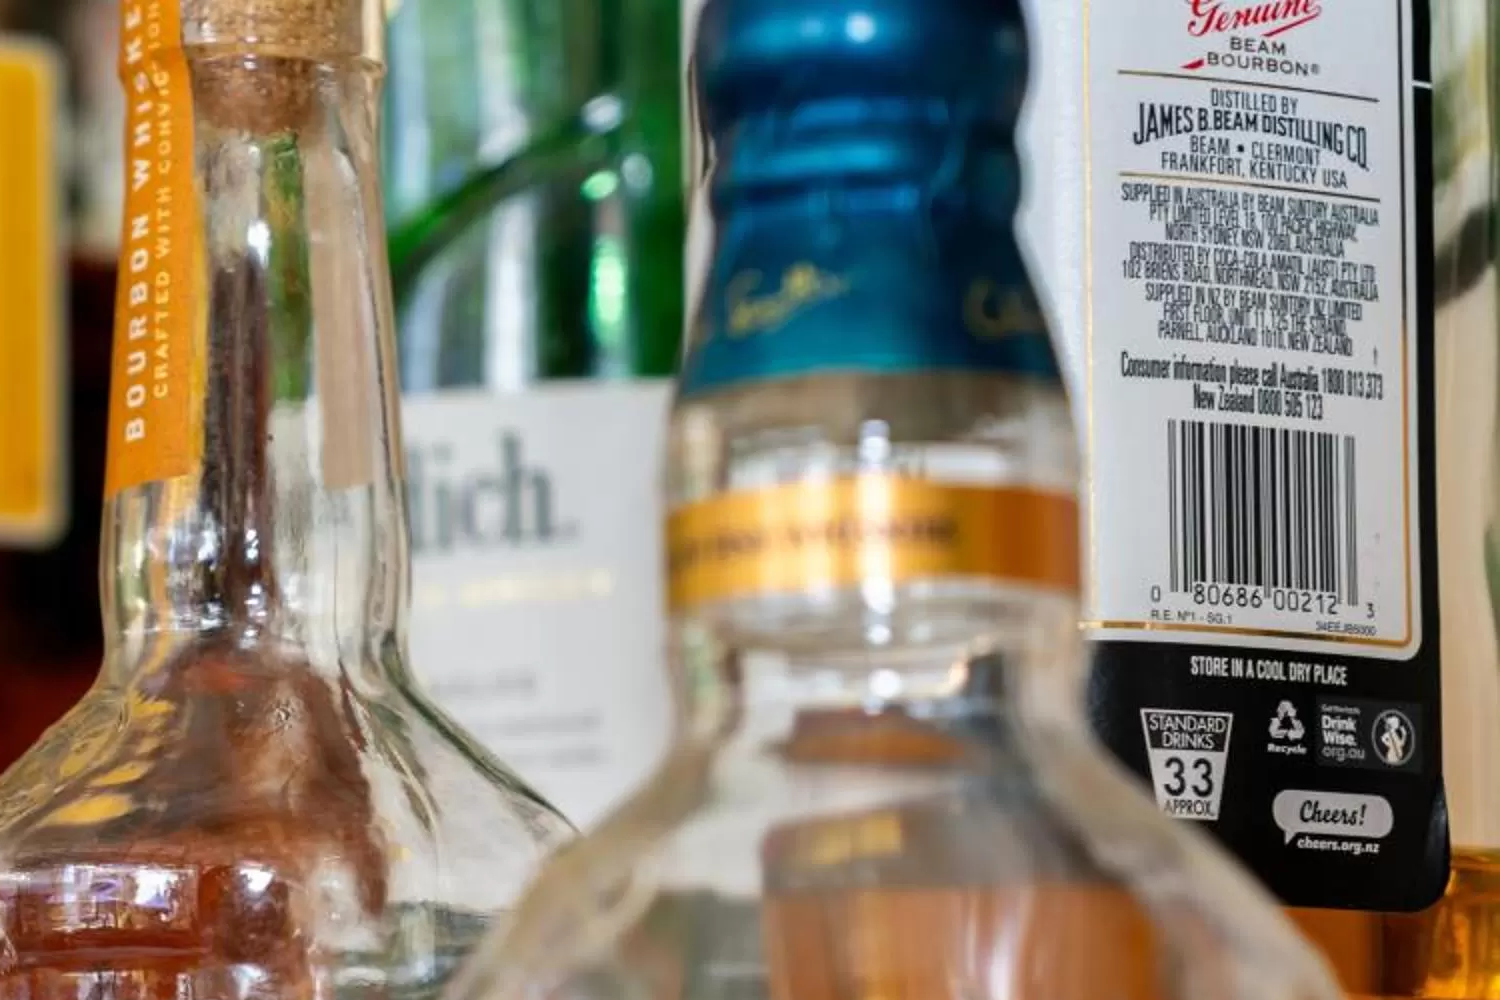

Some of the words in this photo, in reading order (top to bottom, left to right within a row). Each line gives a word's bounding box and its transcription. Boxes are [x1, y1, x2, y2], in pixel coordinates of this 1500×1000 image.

[1188, 0, 1321, 36] Genuine
[1230, 37, 1286, 55] BEAM
[124, 0, 152, 191] WHISKE
[1210, 88, 1276, 113] DISTILLED
[1281, 96, 1298, 114] BY
[1133, 102, 1194, 145] JAMES
[1213, 110, 1258, 132] BEAM
[1261, 115, 1343, 155] DISTILLING
[1190, 135, 1231, 156] BEAM
[1251, 141, 1321, 165] CLERMONT
[1161, 151, 1245, 178] FRANKFORT,
[1250, 161, 1317, 184] KENTUCKY
[1322, 168, 1348, 189] USA
[1121, 181, 1169, 204] SUPPLIED
[1173, 186, 1182, 205] IN
[1186, 188, 1238, 211] AUSTRALIA
[1242, 194, 1253, 212] BY
[1258, 195, 1284, 215] BEAM
[1332, 203, 1378, 225] AUSTRALIA
[1150, 202, 1168, 221] PTY
[1173, 205, 1210, 225] LIMITED
[1214, 209, 1239, 228] LEVEL
[155, 187, 172, 259] WITH
[1165, 222, 1197, 242] NORTH
[1241, 229, 1262, 248] NSW
[1296, 235, 1344, 256] AUSTRALIA
[1129, 240, 1193, 264] DISTRIBUTED
[1197, 247, 1210, 266] BY
[1213, 248, 1266, 271] COCA-COLA
[1341, 261, 1357, 280] PTY
[1123, 260, 1140, 279] 102
[1278, 274, 1299, 294] NSW
[1332, 279, 1378, 301] AUSTRALIA
[1146, 282, 1192, 304] SUPPLIED
[1196, 286, 1204, 305] IN
[1208, 288, 1219, 307] NZ
[1224, 289, 1236, 308] BY
[1240, 291, 1265, 311] BEAM
[1328, 300, 1362, 320] LIMITED
[1164, 302, 1189, 321] FIRST
[1291, 314, 1306, 332] THE
[124, 214, 149, 443] BOURBON
[153, 271, 171, 398] CRAFTED
[1206, 324, 1256, 346] AUCKLAND
[1288, 332, 1308, 351] NEW
[1312, 334, 1351, 356] ZEALAND
[1121, 350, 1171, 379] Consumer
[1173, 353, 1226, 383] information
[1230, 357, 1259, 390] please
[1262, 361, 1277, 387] call
[1280, 362, 1318, 392] Australia
[1193, 382, 1215, 410] New
[1218, 385, 1254, 413] Zealand
[1258, 388, 1282, 416] 0800
[1306, 393, 1323, 420] 123
[1150, 584, 1161, 603] 0
[1193, 584, 1263, 609] 80686
[1273, 590, 1338, 616] 00212
[1366, 602, 1375, 619] 3
[1190, 655, 1228, 677] STORE
[1231, 658, 1243, 677] IN
[1245, 659, 1254, 679] A
[1256, 660, 1286, 681] COOL
[1289, 662, 1311, 683] DRY
[1313, 664, 1347, 686] PLACE
[1150, 714, 1226, 733] STANDARD
[1162, 731, 1215, 749] DRINKS
[1321, 714, 1356, 732] Drink
[1267, 743, 1307, 756] Recycle
[1163, 757, 1213, 798] 33
[1300, 800, 1367, 826] Cheers!
[1297, 837, 1380, 855] cheers.org.nz
